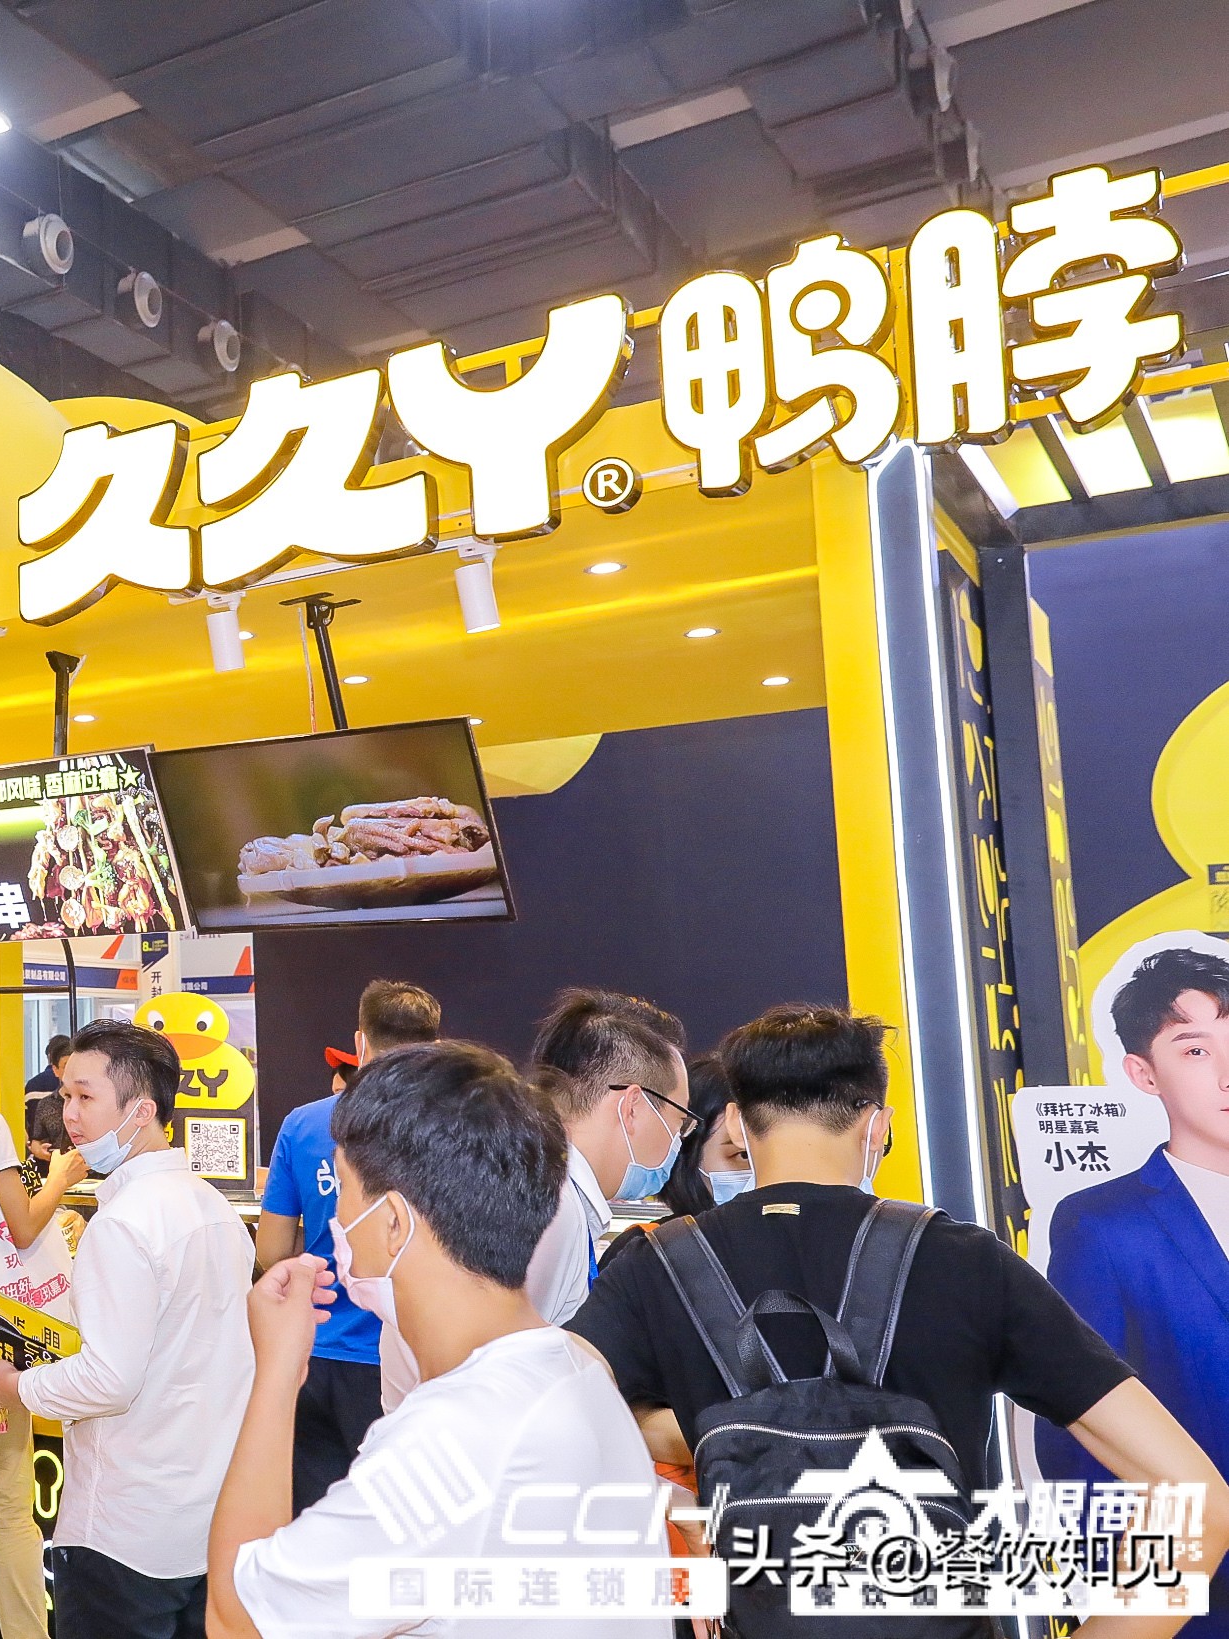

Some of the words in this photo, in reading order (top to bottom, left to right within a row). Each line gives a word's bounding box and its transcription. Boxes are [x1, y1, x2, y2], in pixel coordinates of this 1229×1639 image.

[1035, 1102, 1127, 1118] 《拜托了冰箱》
[1038, 1119, 1100, 1135] 明星嘉宾
[1044, 1141, 1112, 1172] 小杰
